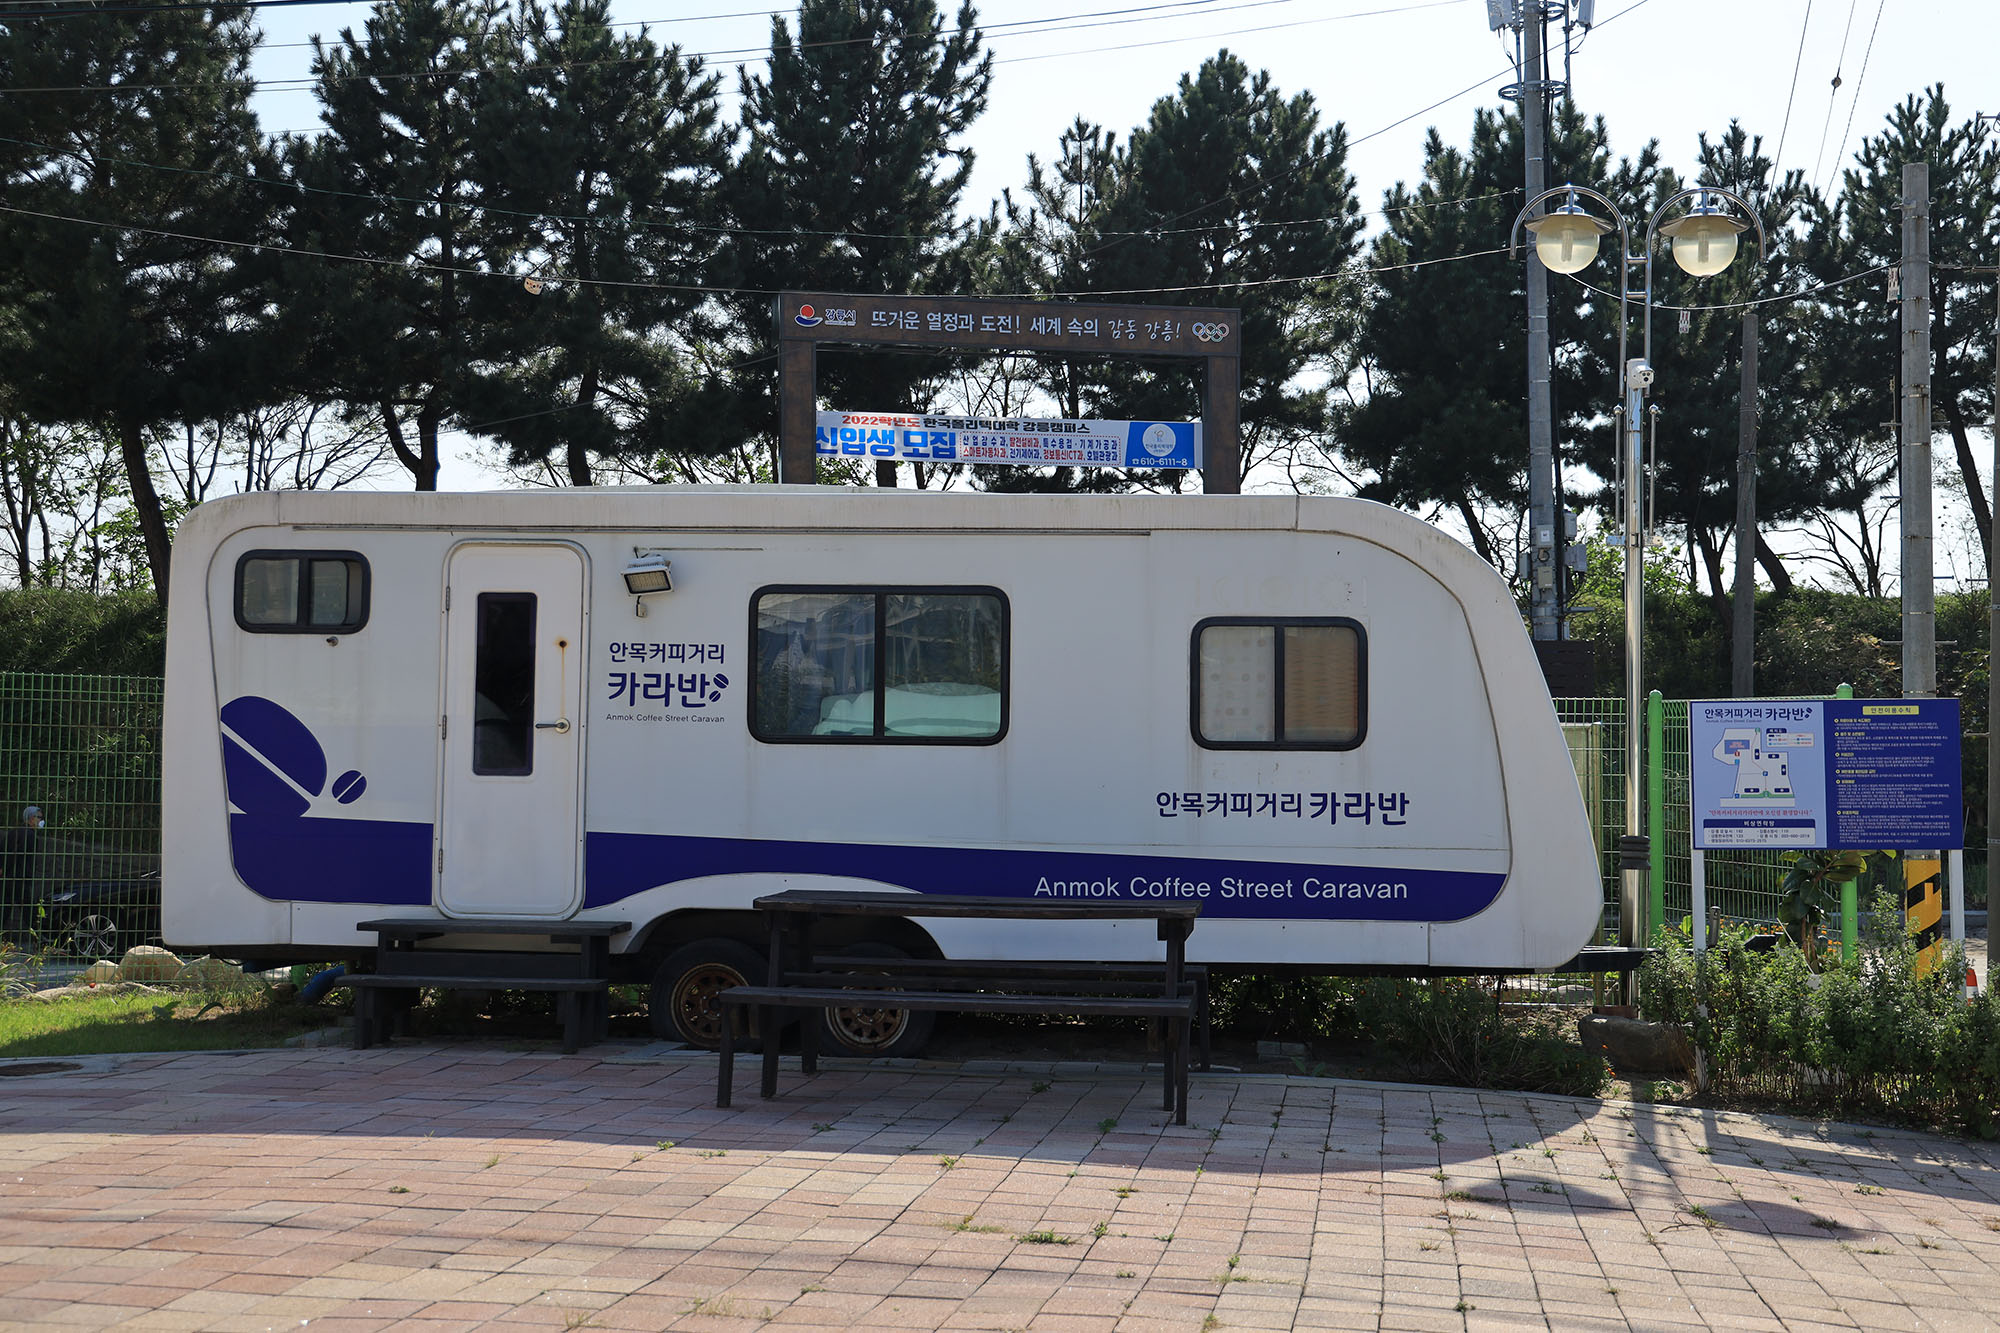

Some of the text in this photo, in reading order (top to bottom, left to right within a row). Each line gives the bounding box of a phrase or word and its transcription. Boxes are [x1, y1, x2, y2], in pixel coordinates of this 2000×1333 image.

[871, 311, 1181, 342] 뜨거운 열정과 도전! 세계 속의 감동 강릉!
[842, 415, 1091, 434] 2022학년도 한국폴리텍대학 강릉캠퍼스
[816, 426, 957, 459] 신입생 모집
[609, 642, 725, 664] 안목커피거리
[608, 672, 711, 708] 카라반
[606, 713, 725, 723] Anmok Coffee Street Caravan
[1704, 707, 1805, 721] 안목커피거리 카라반
[1156, 791, 1411, 825] 안목커피거리 카라반
[1034, 877, 1408, 899] Anmok Coffee Street Caravan
